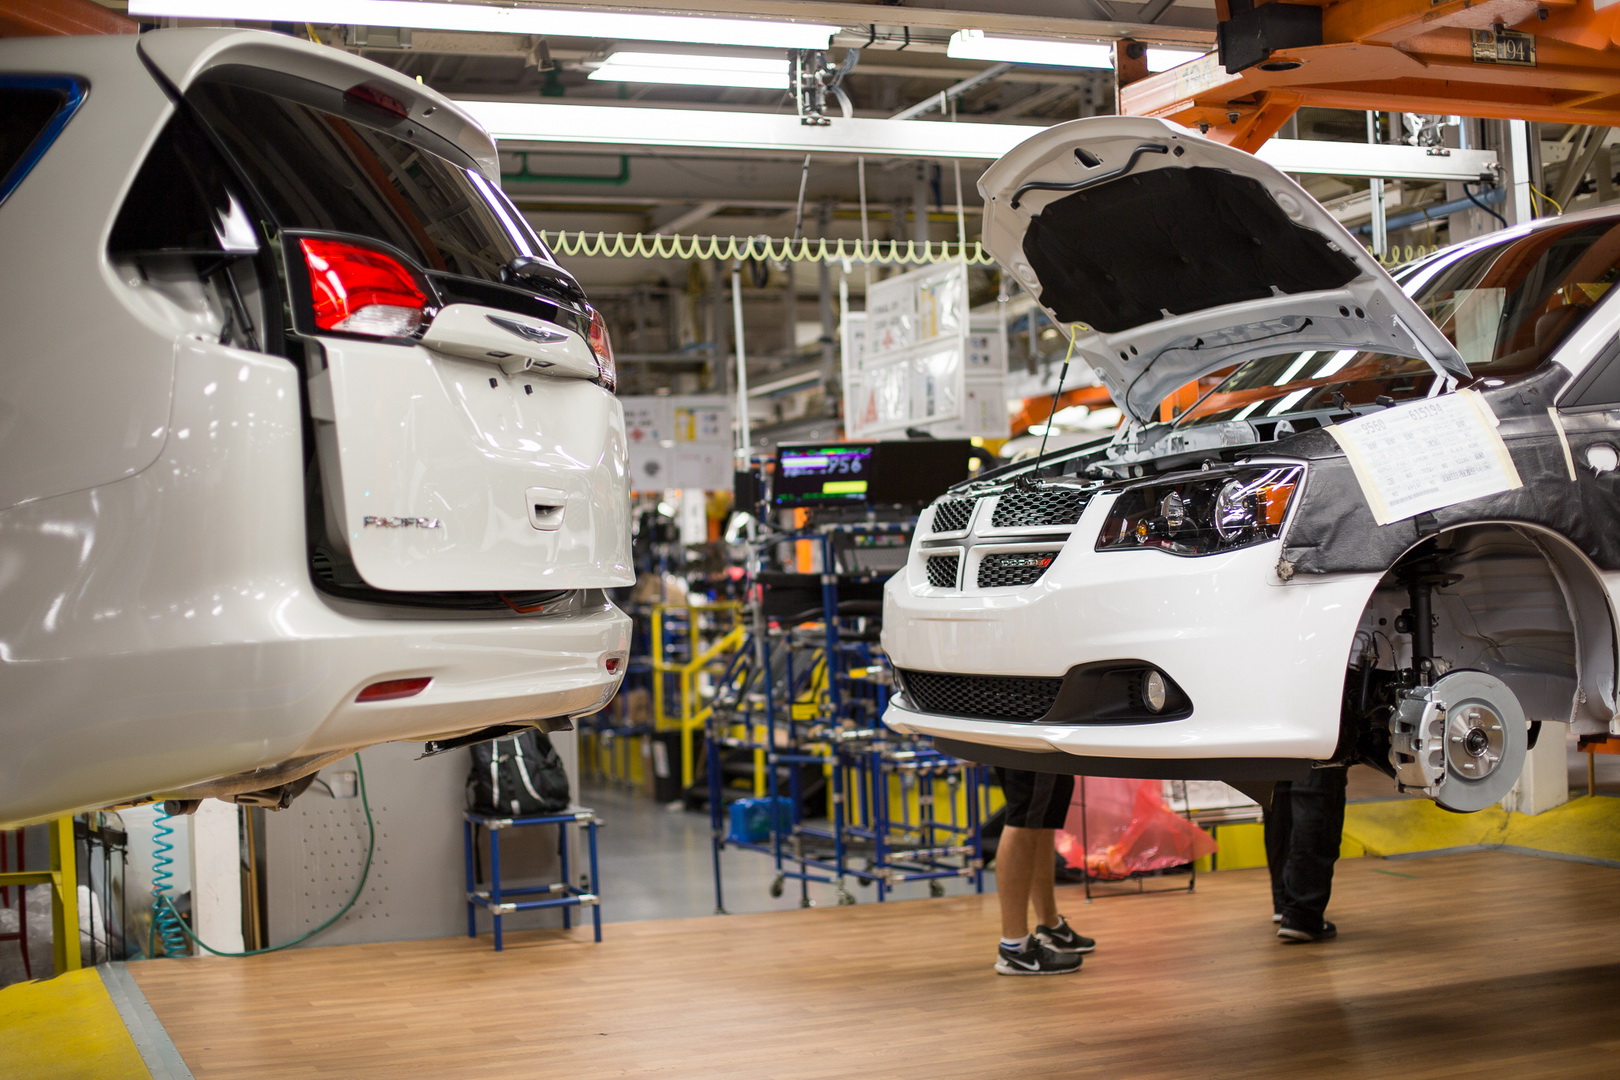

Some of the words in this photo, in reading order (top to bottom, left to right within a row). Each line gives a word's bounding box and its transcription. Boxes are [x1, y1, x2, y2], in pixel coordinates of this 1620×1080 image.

[1503, 39, 1525, 61] 194
[1360, 418, 1387, 435] 9560
[1408, 403, 1444, 421] 615194
[363, 515, 441, 529] PACIFICA
